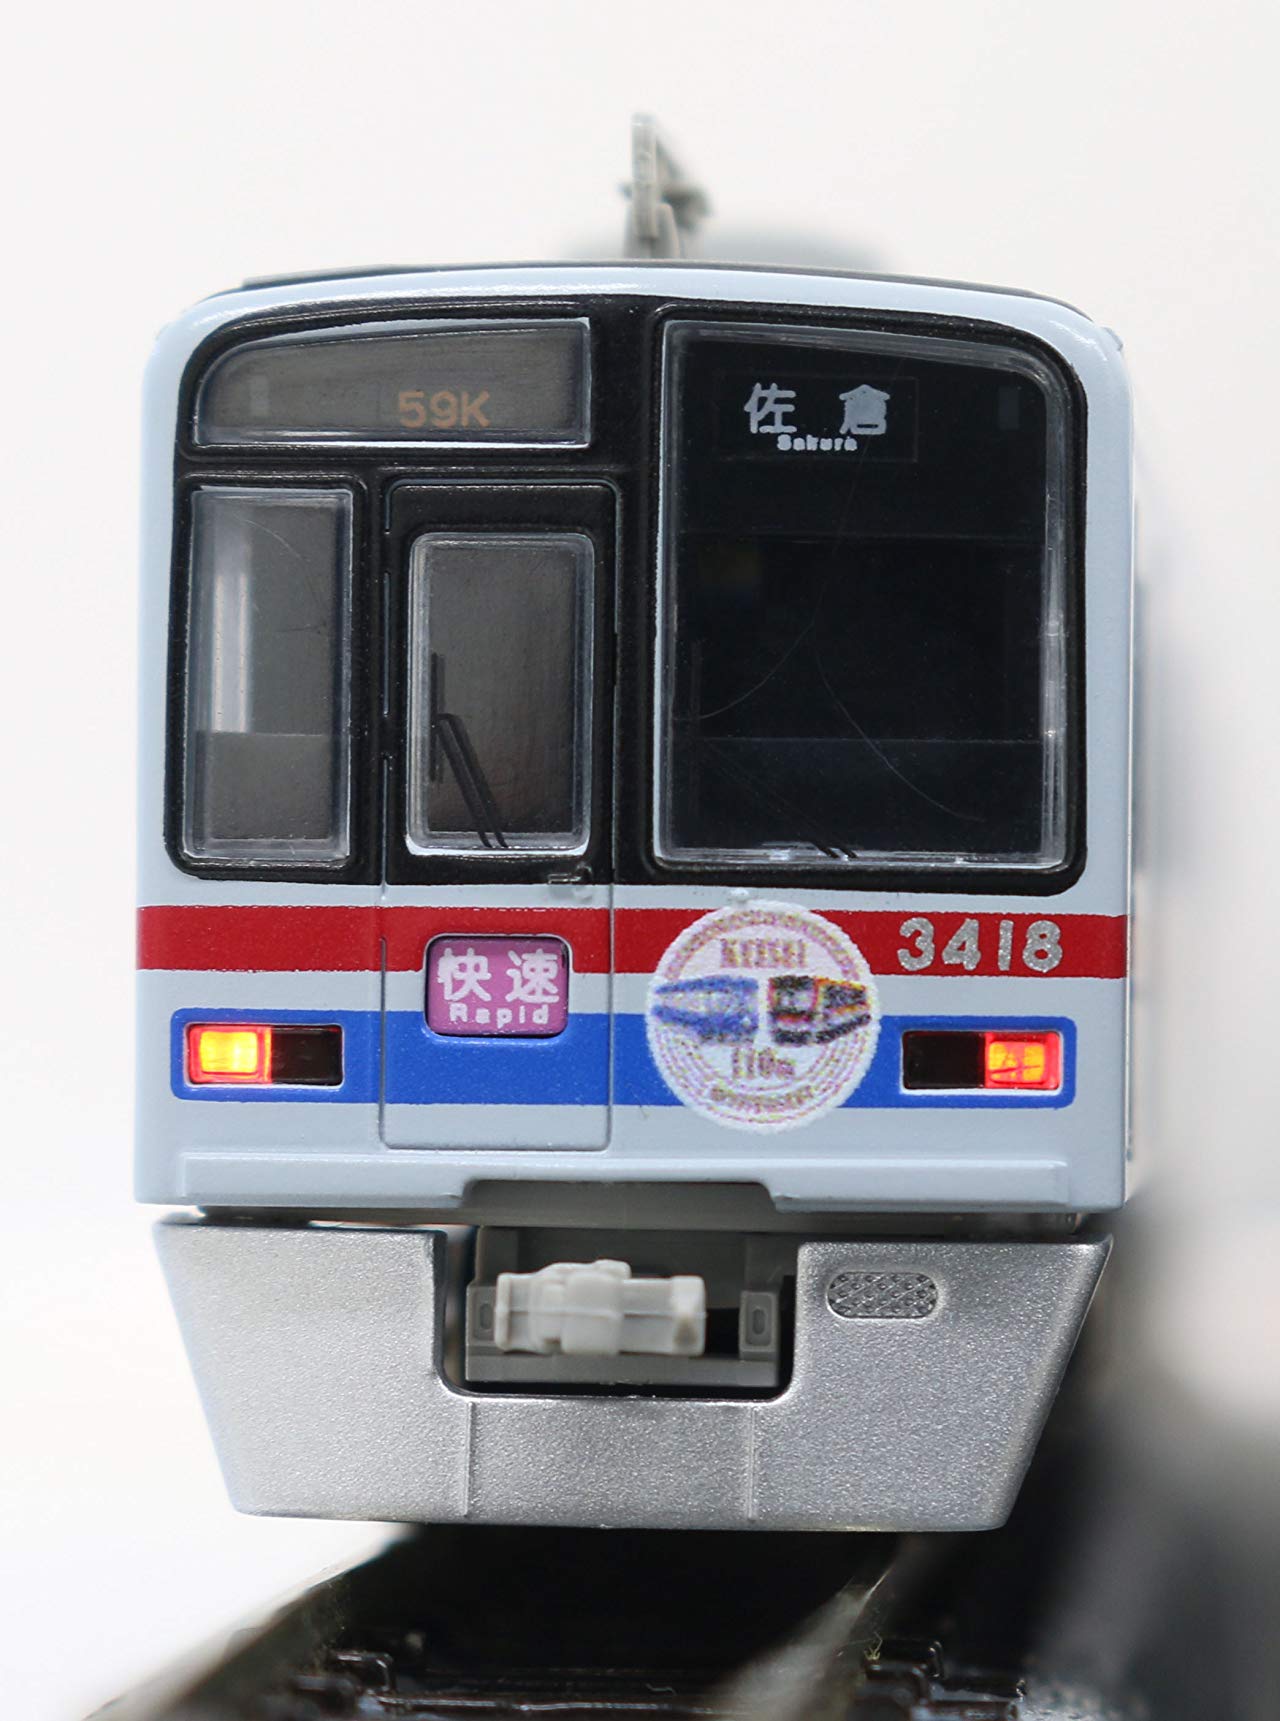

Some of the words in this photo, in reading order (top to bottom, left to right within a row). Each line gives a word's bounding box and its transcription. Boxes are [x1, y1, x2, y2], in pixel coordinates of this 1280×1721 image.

[399, 389, 490, 429] 59K
[776, 433, 859, 453] Sakura
[899, 916, 1065, 974] 3418
[437, 947, 562, 1004] 快速
[449, 1003, 550, 1026] Rapid
